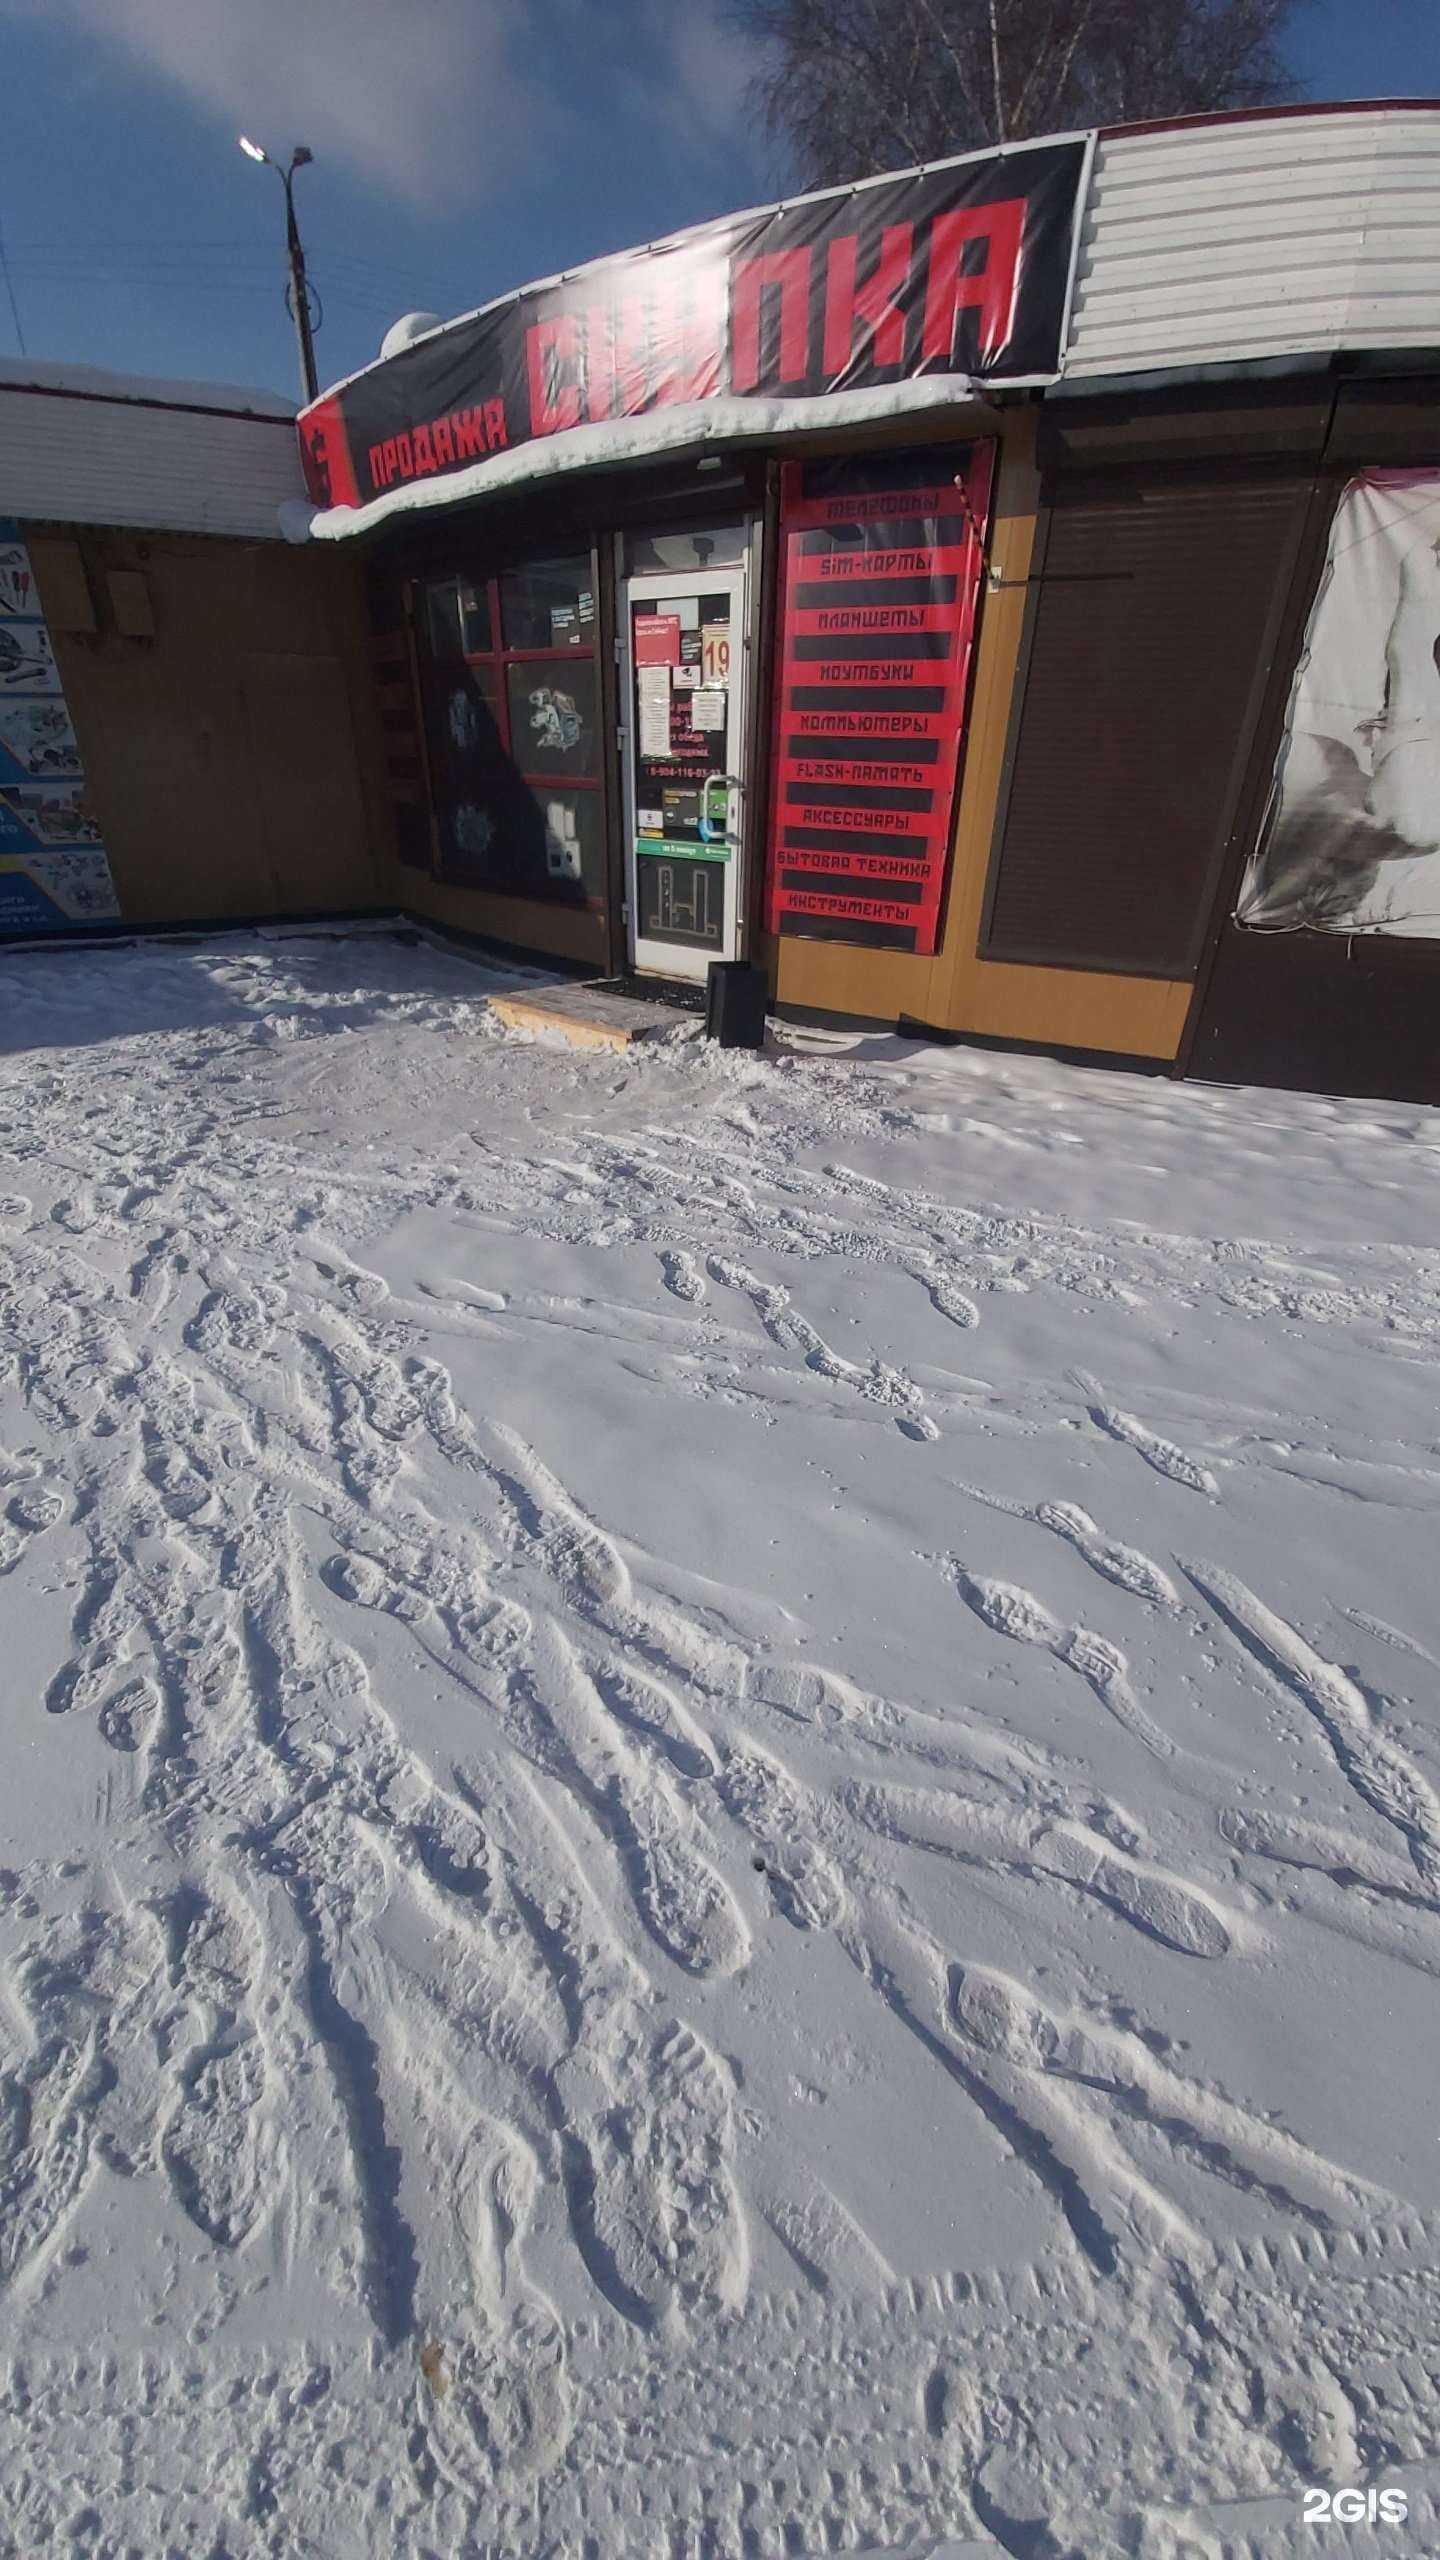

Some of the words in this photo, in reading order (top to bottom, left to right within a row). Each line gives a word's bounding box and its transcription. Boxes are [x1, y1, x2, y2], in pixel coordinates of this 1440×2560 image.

[369, 396, 508, 489] ПРОДАЖА
[803, 808, 909, 830] АКСЕССУАРЫ
[855, 857, 931, 879] ТЕХНИКА
[789, 893, 910, 920] ИНСТРУМЕНТЫ
